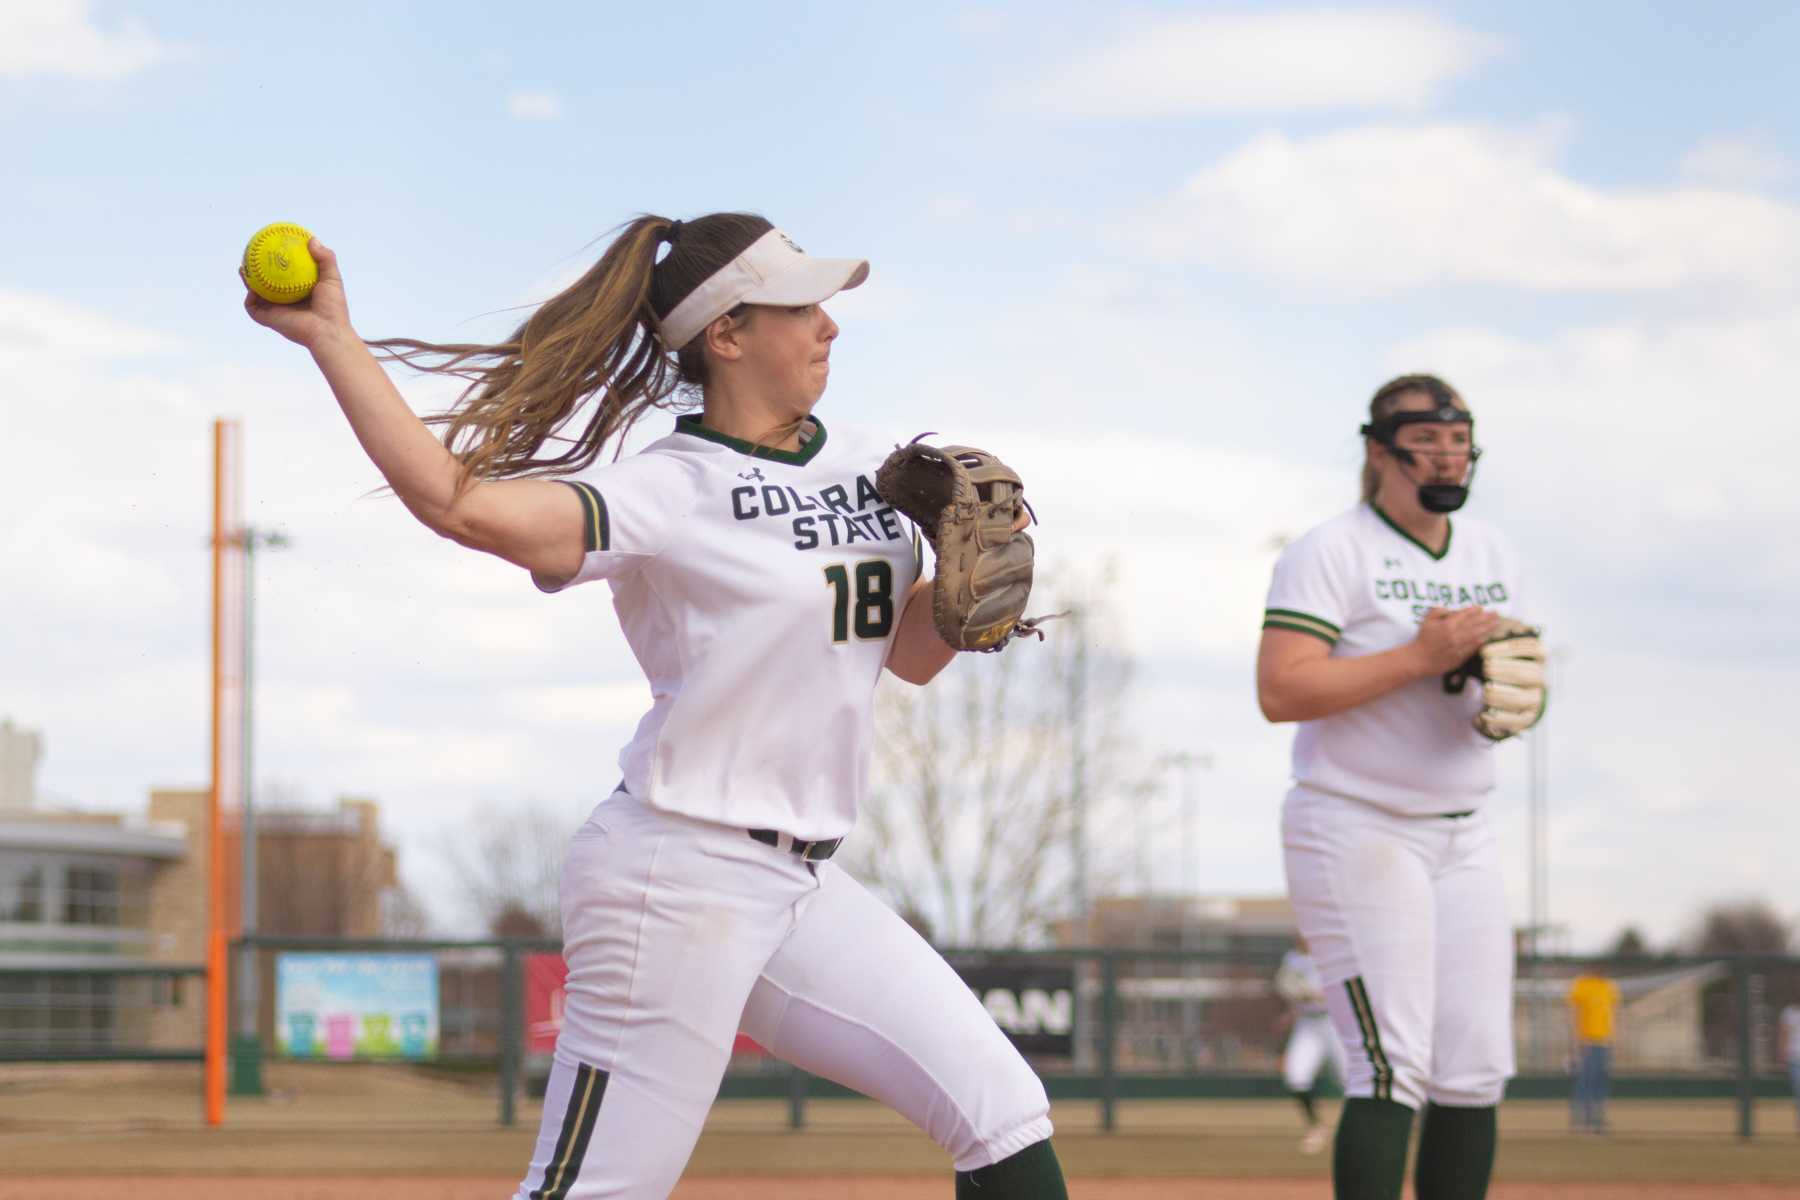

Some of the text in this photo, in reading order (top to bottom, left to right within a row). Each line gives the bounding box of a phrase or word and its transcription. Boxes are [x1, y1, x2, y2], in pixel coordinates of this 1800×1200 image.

[731, 474, 885, 520] COLRA
[792, 507, 901, 550] STATE
[821, 558, 895, 645] 18
[1375, 579, 1508, 606] COLORADO
[974, 987, 1072, 1035] AN
